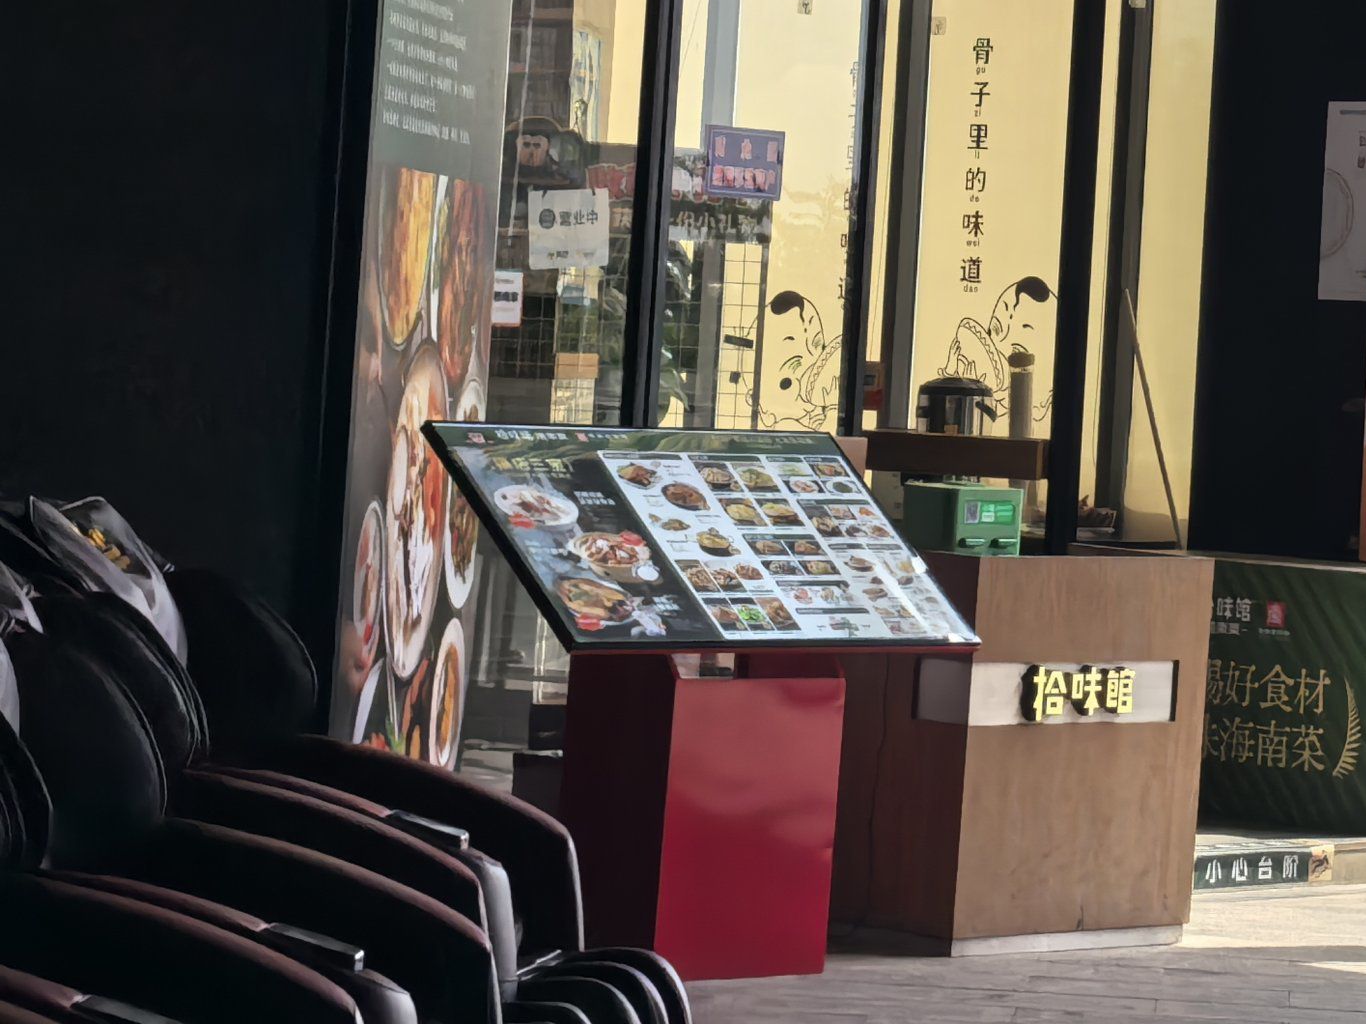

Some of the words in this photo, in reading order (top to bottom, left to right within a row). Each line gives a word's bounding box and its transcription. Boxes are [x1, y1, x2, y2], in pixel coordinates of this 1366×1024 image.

[960, 37, 994, 284] 骨子里的味道
[1213, 596, 1252, 622] 味馆
[1205, 855, 1299, 884] 小心台阶
